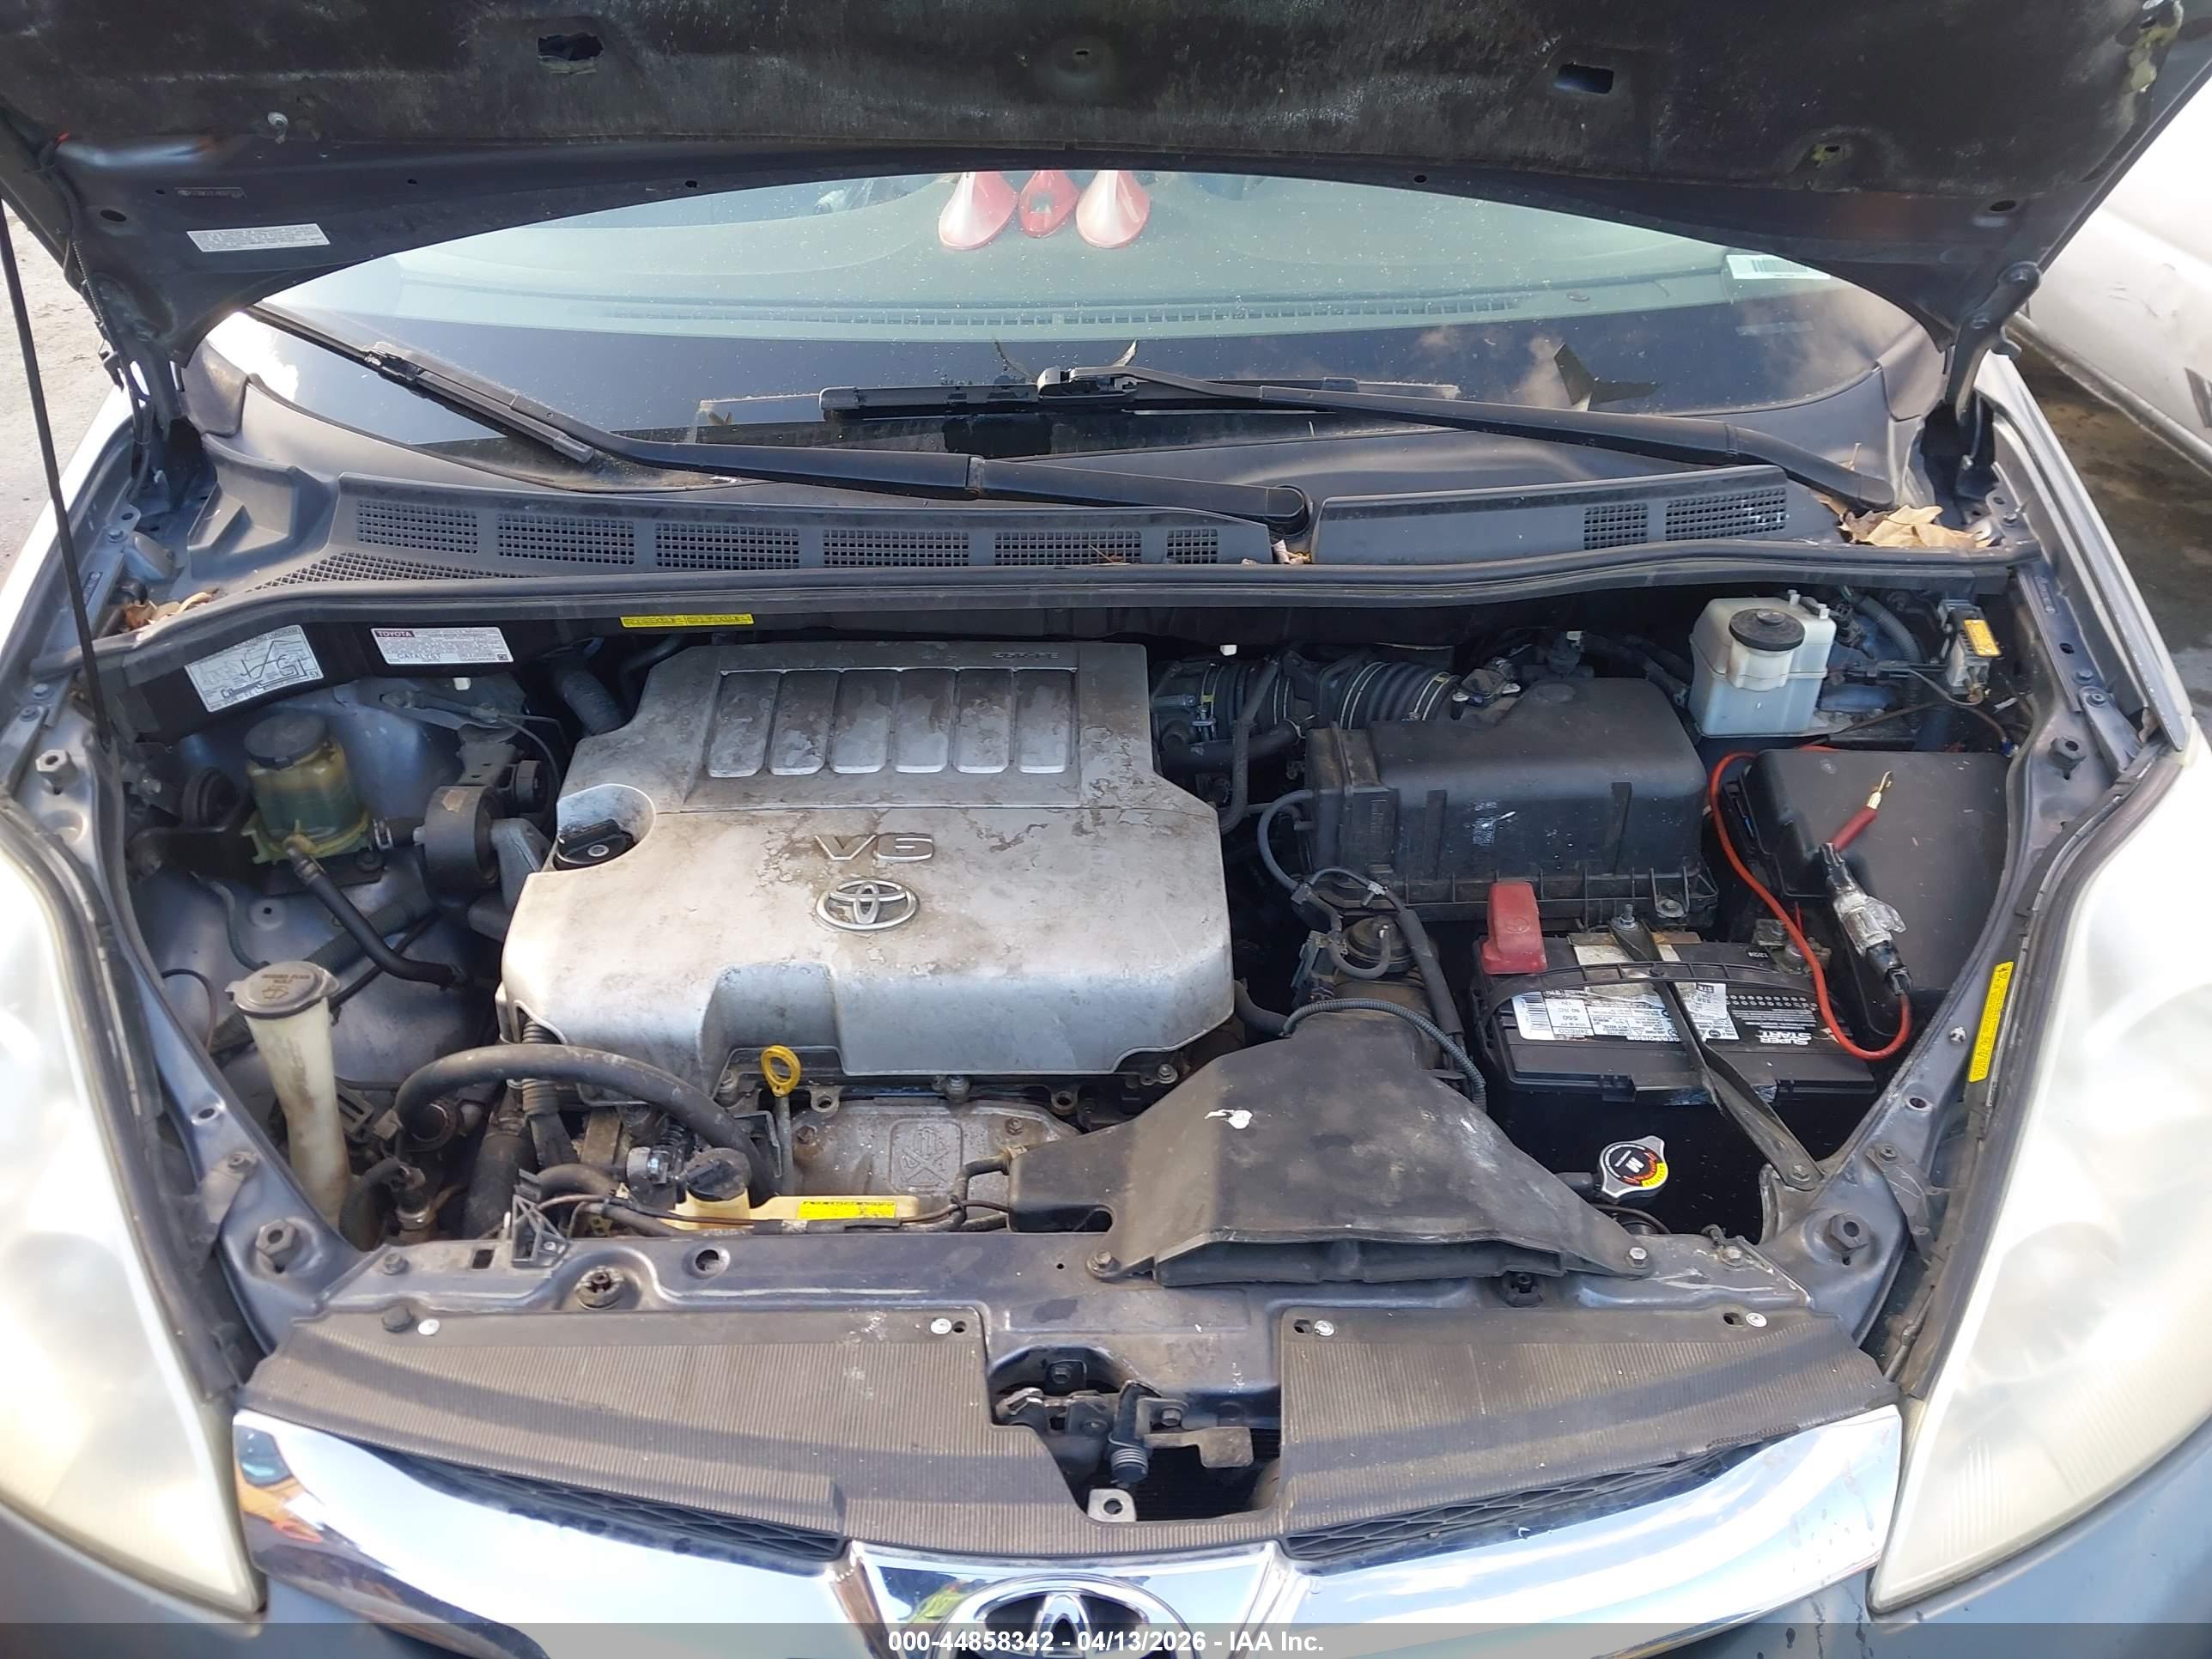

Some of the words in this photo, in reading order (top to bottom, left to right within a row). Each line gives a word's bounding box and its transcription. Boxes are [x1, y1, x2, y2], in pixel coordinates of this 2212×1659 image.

[813, 832, 934, 864] V6
[1756, 1030, 1812, 1040] START
[1760, 1036, 1808, 1045] SUPER
